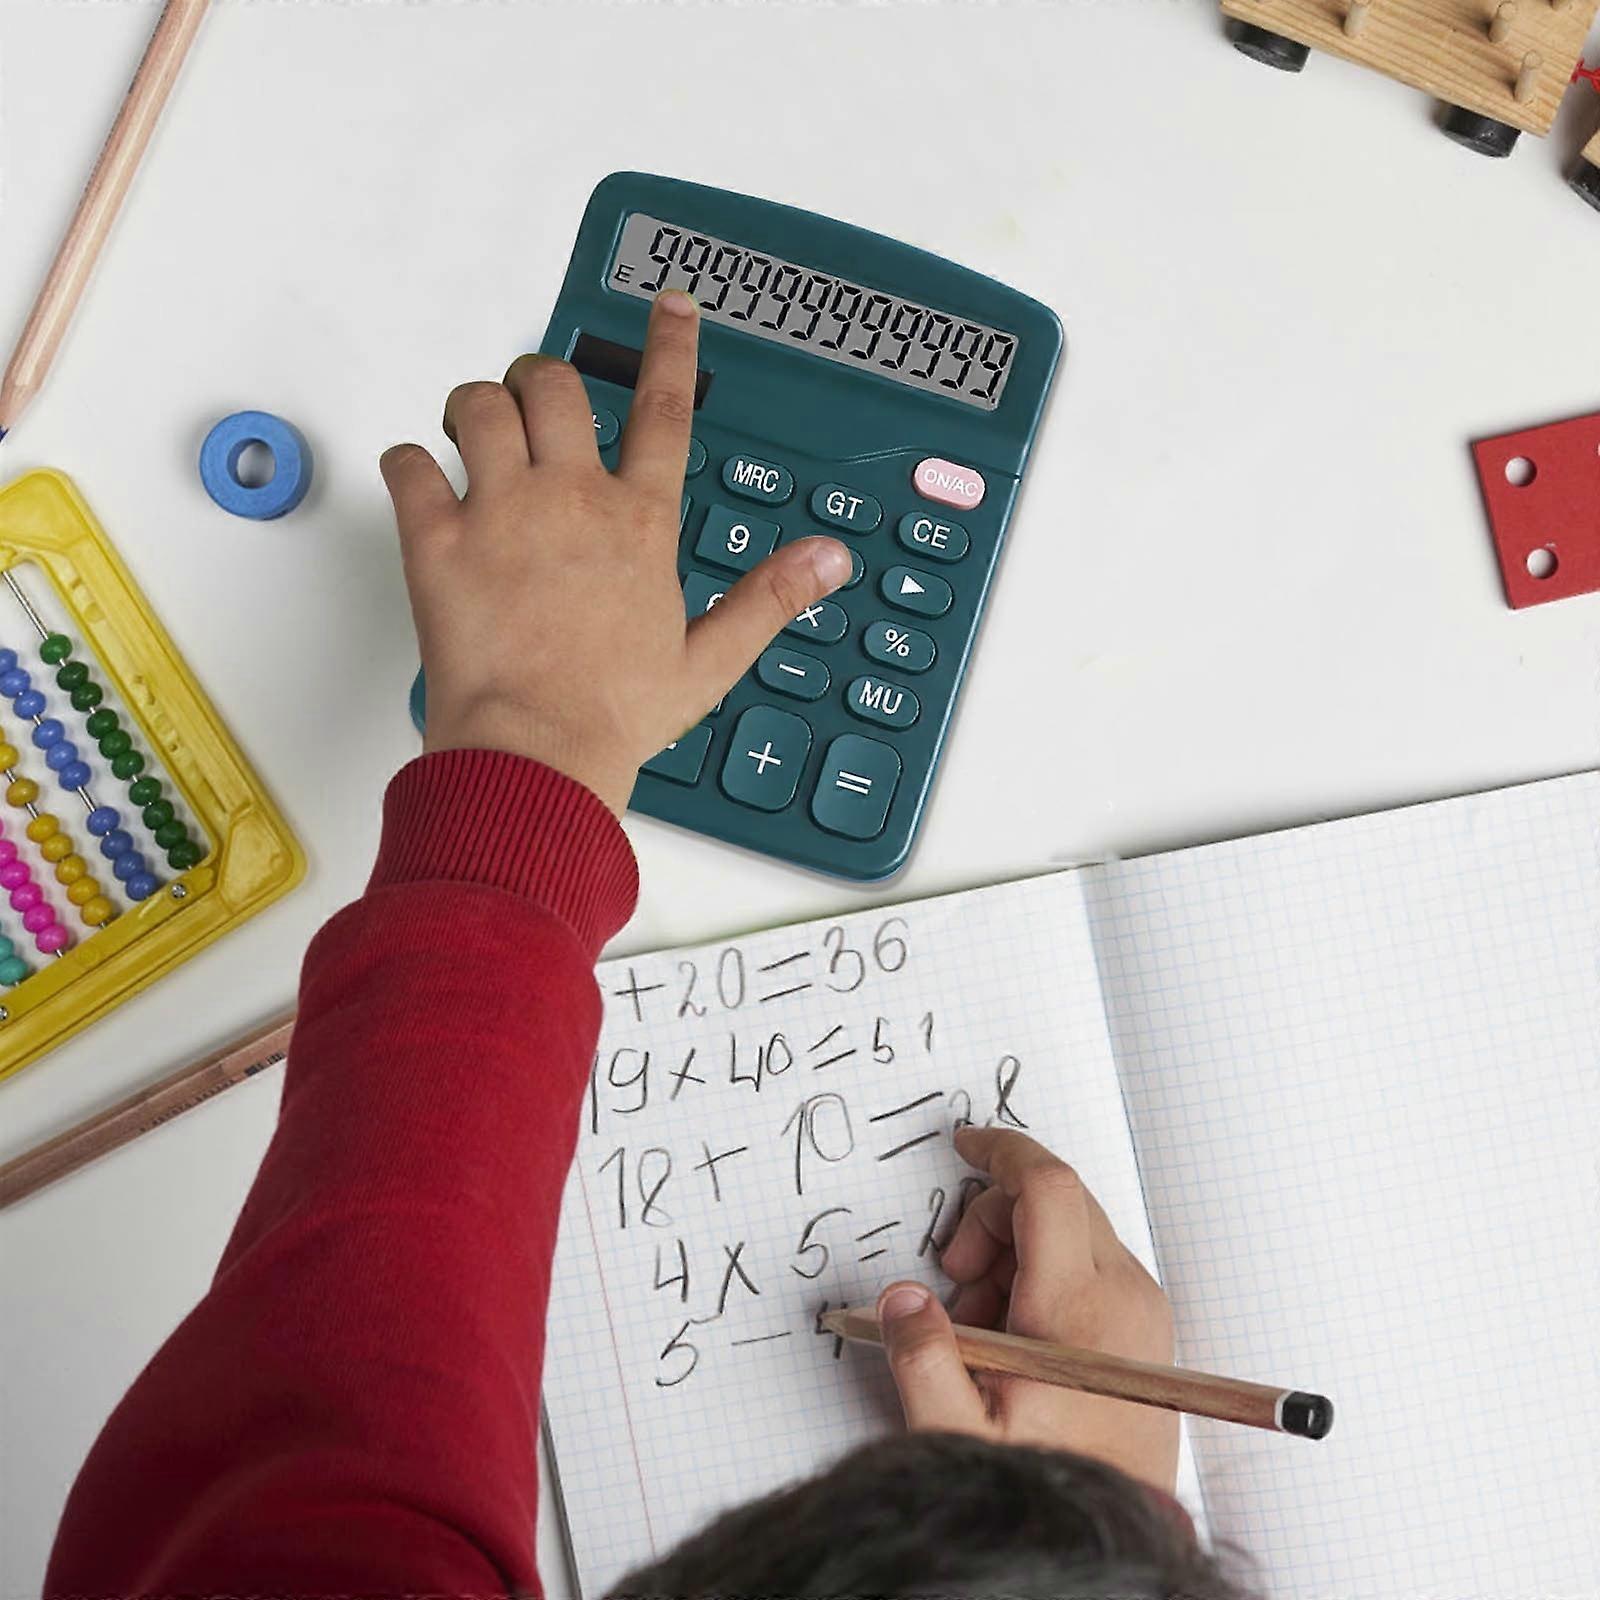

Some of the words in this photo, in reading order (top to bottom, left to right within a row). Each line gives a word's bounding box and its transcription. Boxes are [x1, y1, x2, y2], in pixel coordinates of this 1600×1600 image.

[732, 461, 779, 493] MRC
[922, 467, 979, 497] ON/AC
[826, 491, 863, 521] GT
[726, 526, 750, 554] 9
[912, 519, 951, 549] CE
[885, 629, 909, 658] %
[859, 681, 902, 714] MU
[677, 947, 746, 1018] 20
[822, 918, 909, 993] 36
[591, 1048, 650, 1135] 19
[729, 1031, 793, 1092] 40
[599, 1146, 673, 1229] 18
[781, 1092, 854, 1195] 10
[790, 1208, 852, 1279] 5
[655, 1311, 722, 1387] 5
